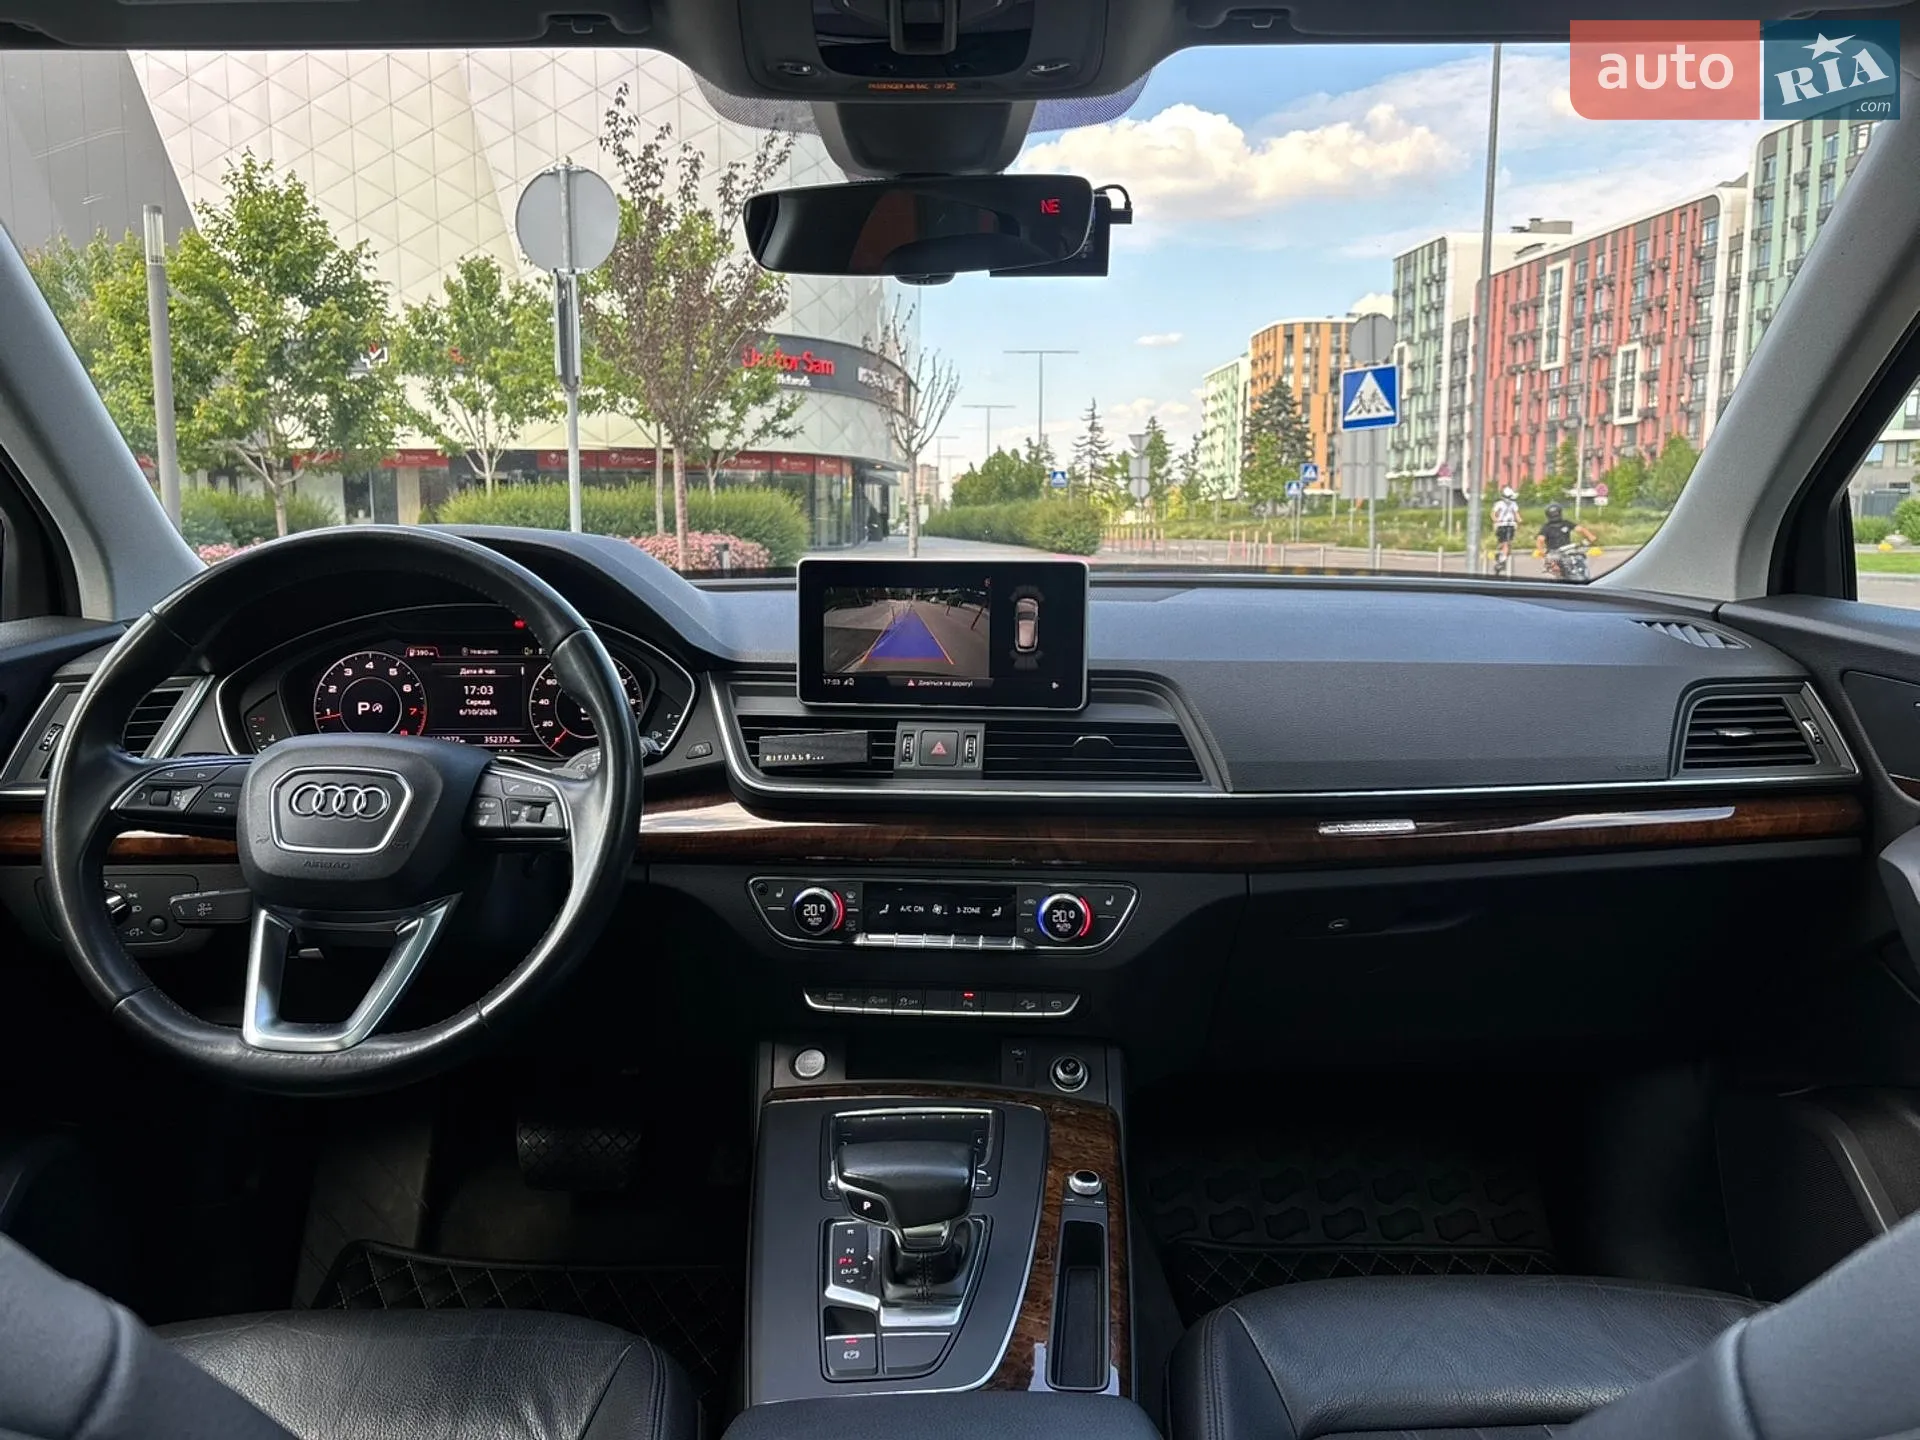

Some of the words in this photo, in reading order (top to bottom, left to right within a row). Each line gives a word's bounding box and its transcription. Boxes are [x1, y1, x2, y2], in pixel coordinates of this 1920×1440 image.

[1041, 198, 1060, 213] NE
[802, 351, 835, 376] Sam
[464, 686, 494, 695] 17:03
[358, 702, 370, 715] P
[863, 1202, 871, 1210] P
